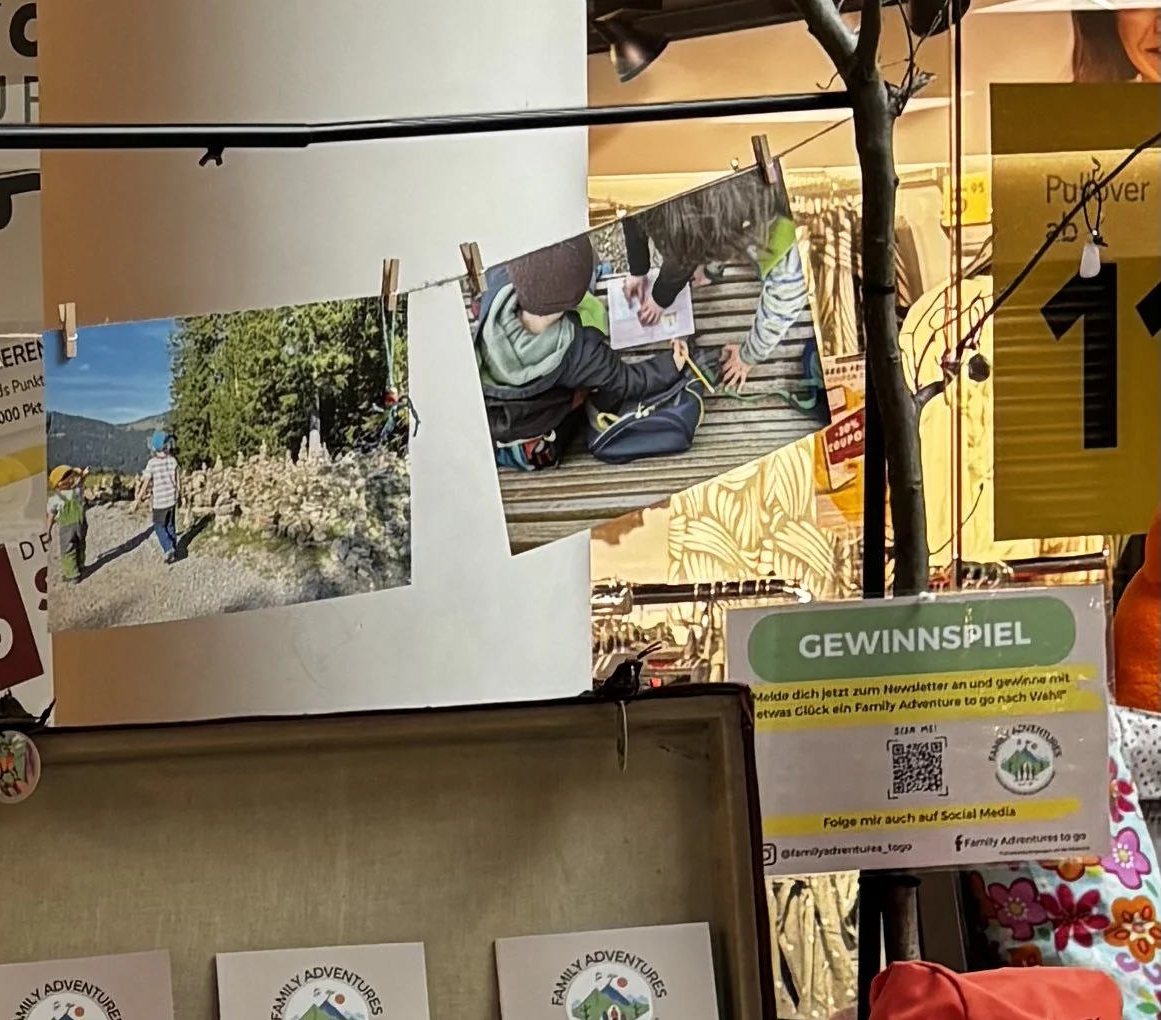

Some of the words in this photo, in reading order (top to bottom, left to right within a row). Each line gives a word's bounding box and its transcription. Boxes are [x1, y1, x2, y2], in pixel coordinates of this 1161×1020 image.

[1041, 262, 1161, 449] 1
[22, 402, 43, 418] Pkt
[799, 621, 1031, 659] GEWINNSPIEL
[792, 687, 819, 701] dich
[822, 685, 849, 701] jetzt
[853, 686, 880, 697] zum
[883, 679, 948, 696] Newsletter
[951, 680, 968, 691] an
[969, 677, 993, 690] und
[996, 675, 1047, 691] gewinne
[1049, 672, 1070, 685] mit
[756, 708, 792, 719] etwas
[794, 703, 829, 717] Glück
[832, 703, 852, 715] ein
[855, 699, 896, 714] Family
[899, 697, 961, 711] Adventure
[964, 696, 977, 706] to
[979, 696, 995, 709] go
[998, 689, 1027, 704] nach
[824, 816, 857, 829] Folge
[860, 814, 882, 827] mir
[885, 812, 916, 825] auch
[918, 811, 938, 823] auf
[941, 808, 977, 821] Social
[980, 806, 1017, 818] Media
[965, 836, 999, 849] Family
[1000, 834, 1058, 846] Adventures
[1060, 832, 1071, 842] to
[1073, 832, 1087, 842] go
[304, 966, 384, 1017] ADVENTURES
[552, 958, 583, 1007] FAMILY
[585, 950, 668, 999] ADVENTURES
